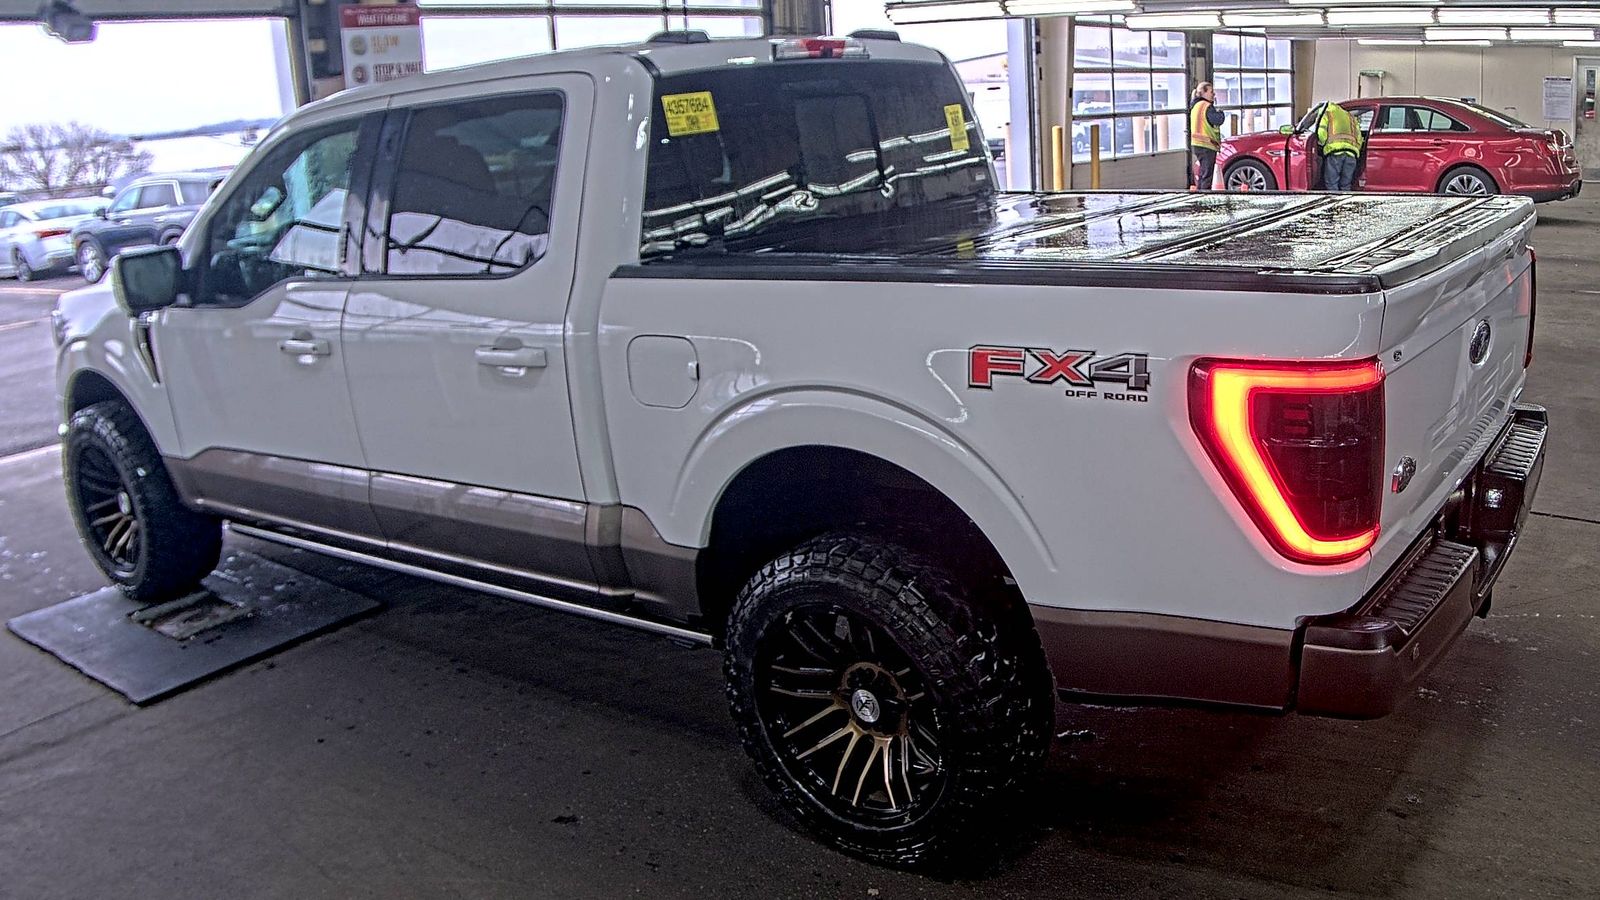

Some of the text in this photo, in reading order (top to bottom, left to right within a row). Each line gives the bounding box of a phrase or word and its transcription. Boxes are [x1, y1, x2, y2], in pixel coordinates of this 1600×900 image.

[373, 63, 395, 75] STOP
[967, 344, 1151, 392] FX4
[1065, 389, 1149, 403] OFF ROAD
